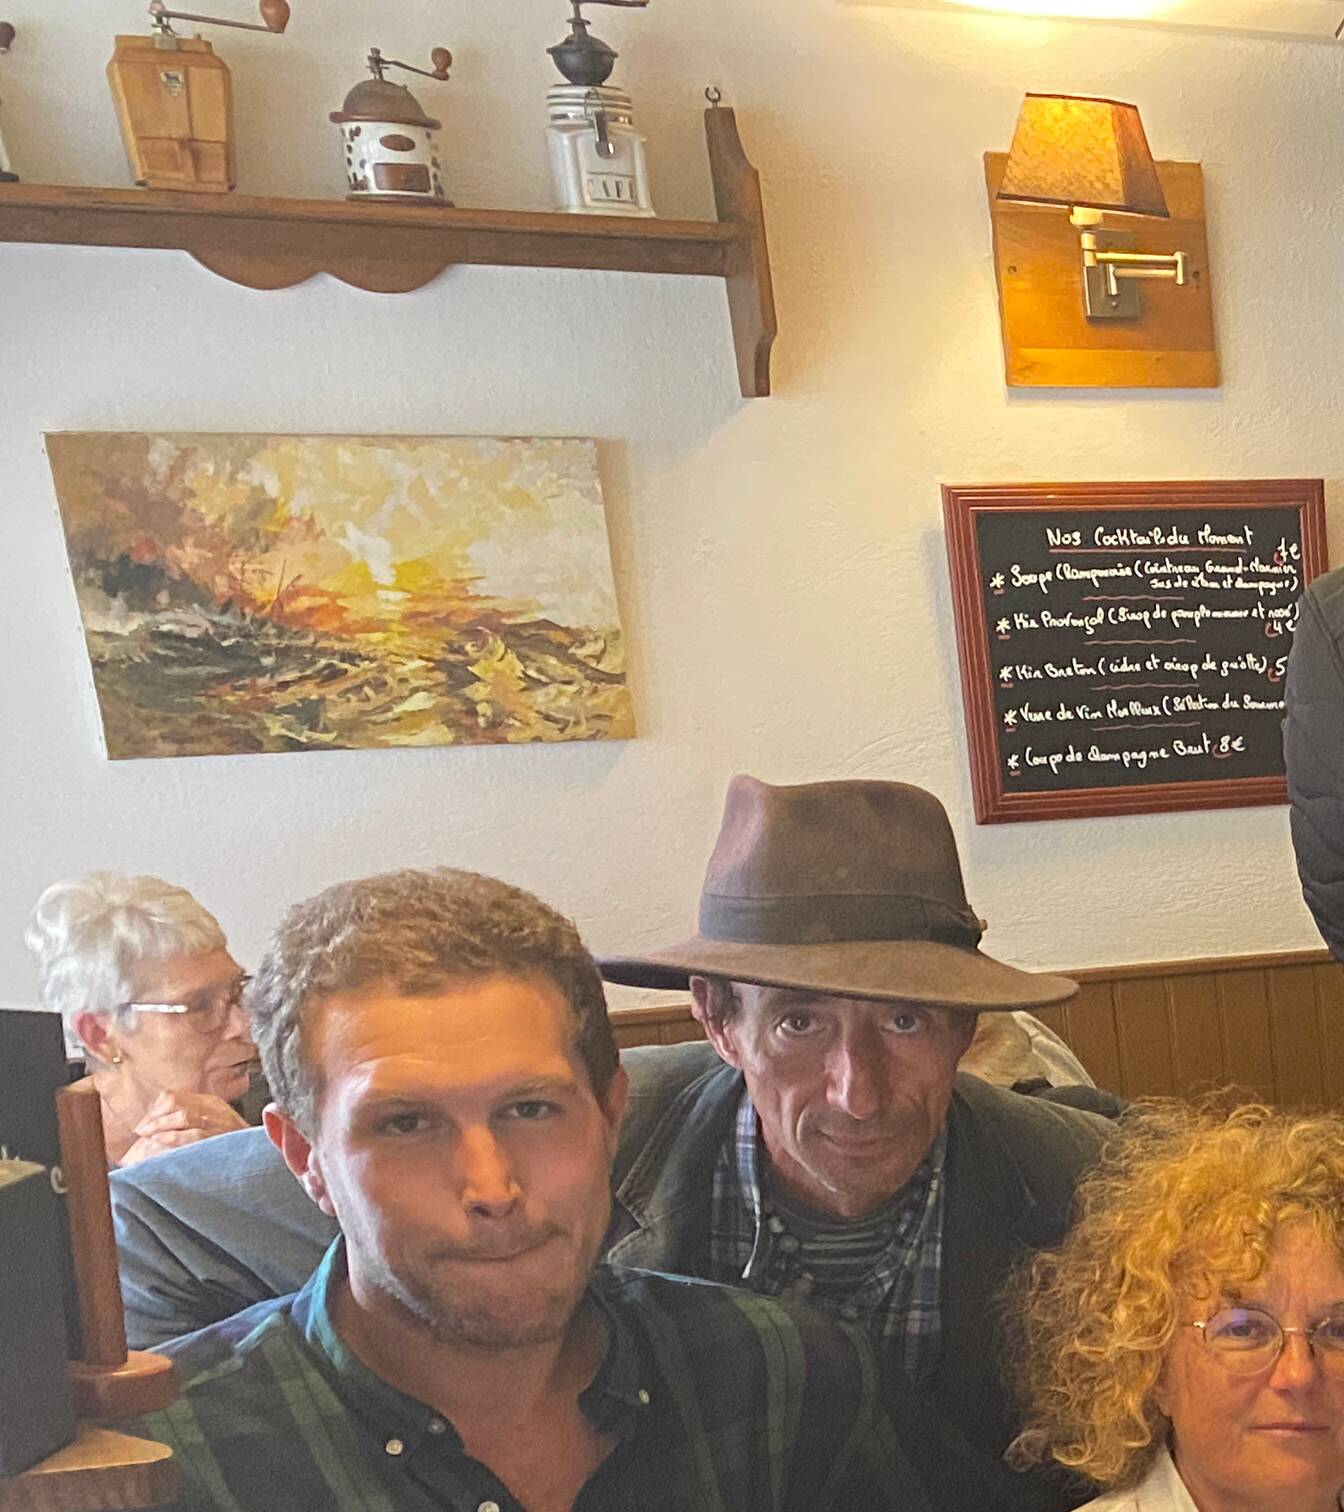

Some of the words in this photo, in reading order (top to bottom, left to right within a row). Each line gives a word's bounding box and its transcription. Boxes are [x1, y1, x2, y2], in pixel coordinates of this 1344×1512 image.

[1046, 527, 1082, 547] Nos
[1166, 525, 1190, 546] du
[1197, 523, 1254, 546] Moment
[1010, 564, 1053, 595] Soupe
[1173, 574, 1188, 589] de
[1222, 573, 1234, 589] et
[1152, 603, 1167, 619] de
[1252, 601, 1265, 620] et
[1145, 653, 1161, 671] et
[1201, 653, 1218, 671] de
[1056, 702, 1074, 721] de
[1221, 692, 1240, 710] du
[1065, 744, 1083, 763] de
